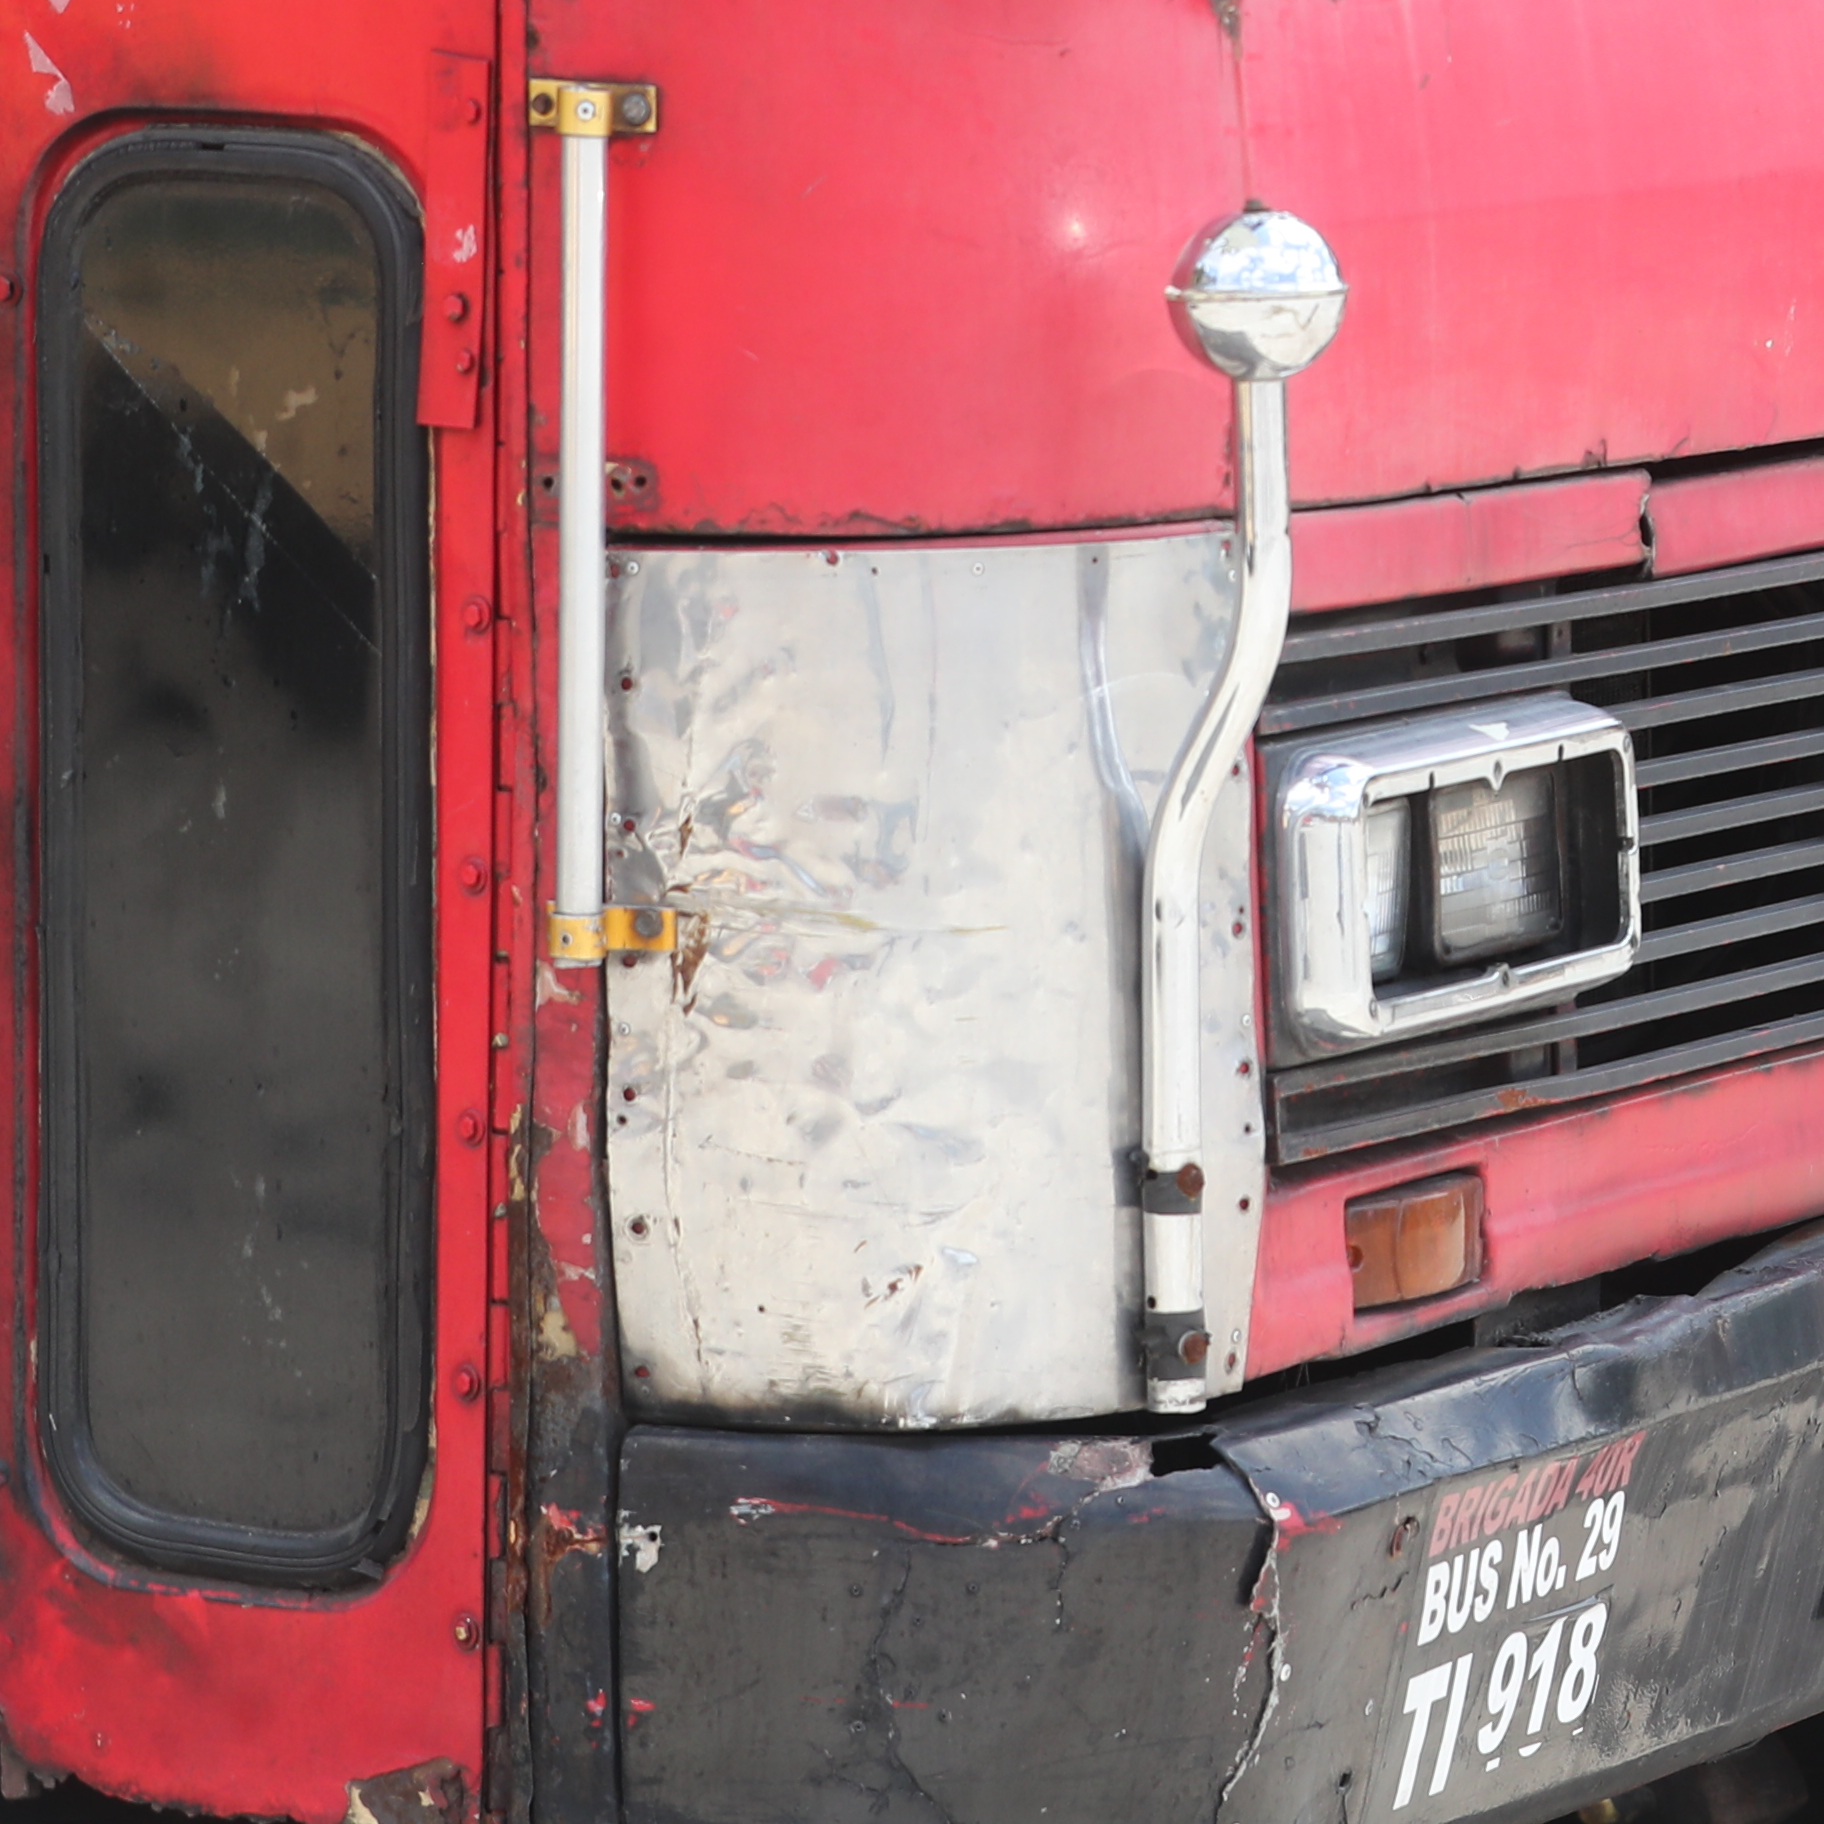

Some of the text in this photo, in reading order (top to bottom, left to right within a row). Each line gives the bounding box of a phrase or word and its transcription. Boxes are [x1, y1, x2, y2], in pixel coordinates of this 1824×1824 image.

[1417, 1490, 1626, 1646] BUS No. 29
[1429, 1430, 1647, 1557] BRIGADA 40R
[1393, 1602, 1608, 1810] TI 918
